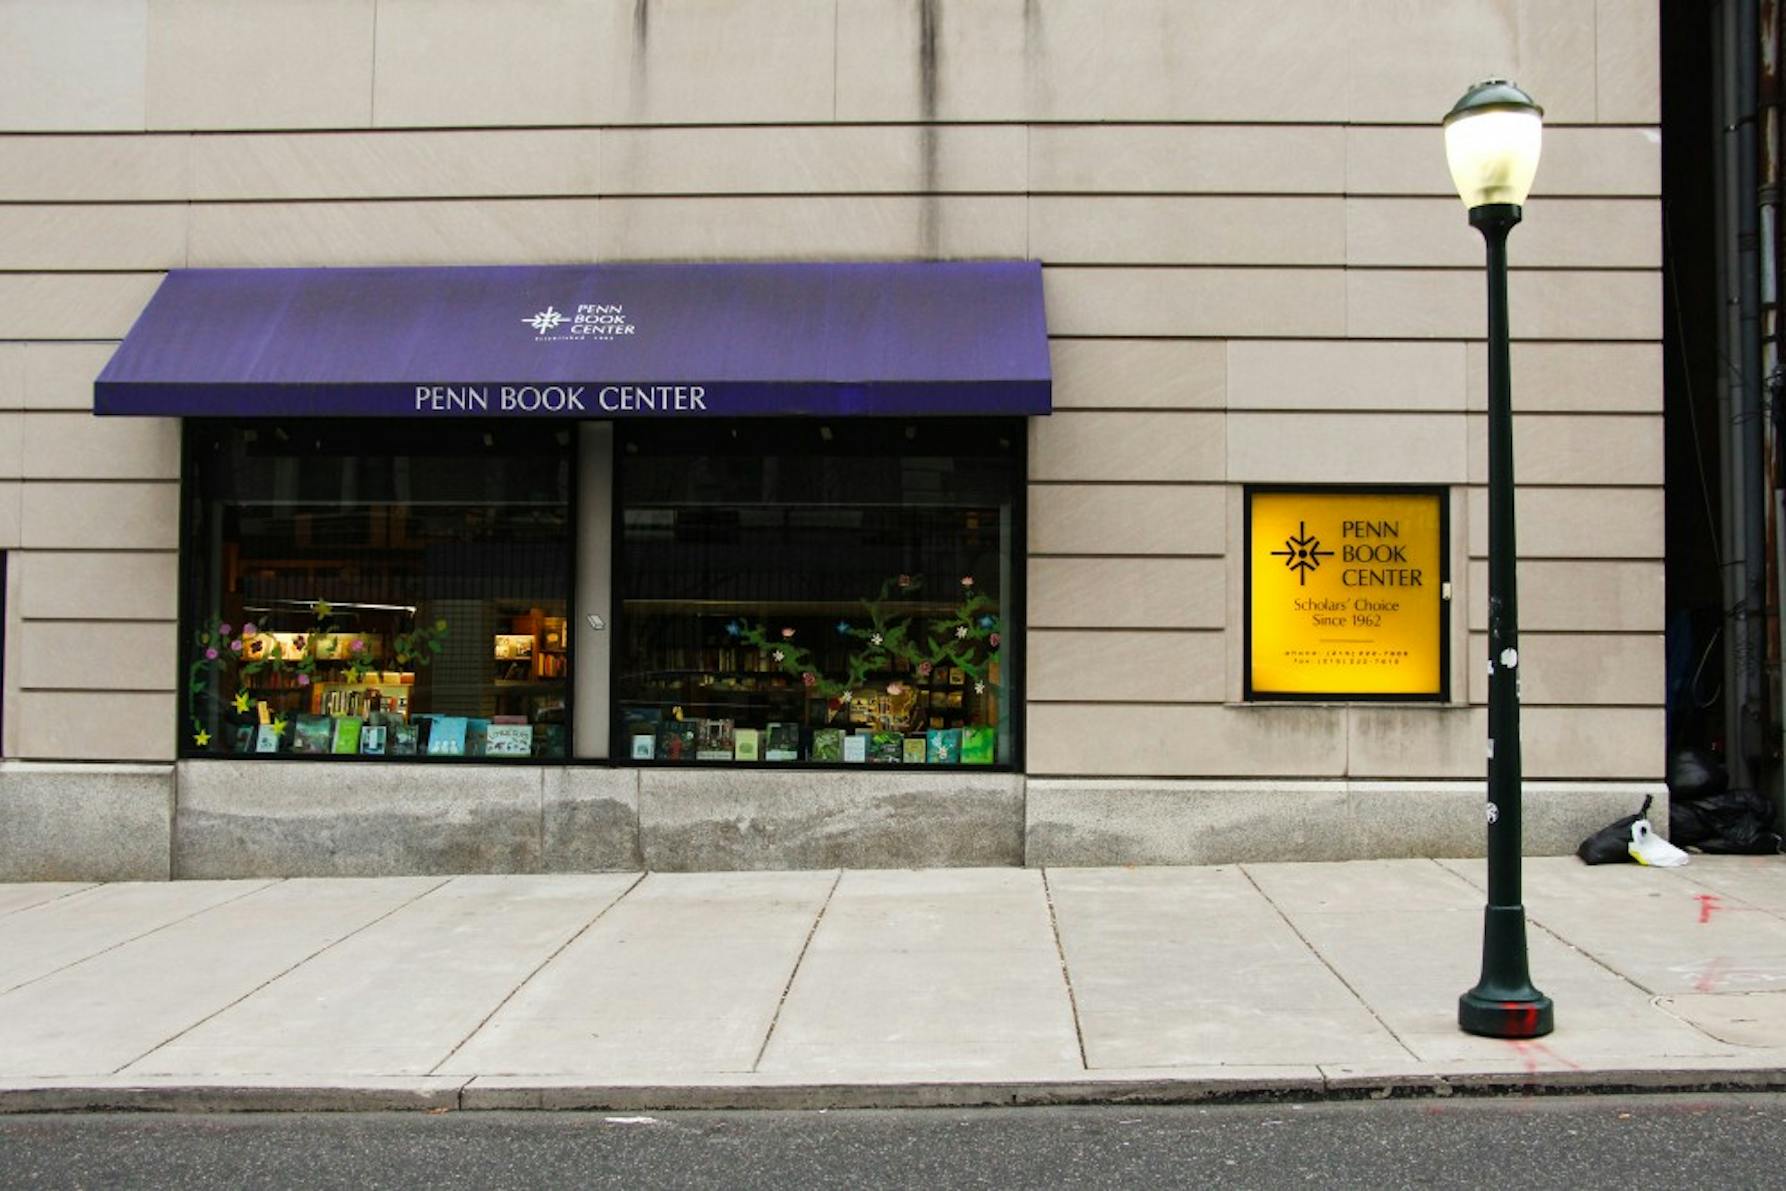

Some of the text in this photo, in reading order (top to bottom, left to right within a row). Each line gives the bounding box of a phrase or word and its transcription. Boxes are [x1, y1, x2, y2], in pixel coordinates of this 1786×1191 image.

[577, 304, 623, 313] PENN
[574, 314, 626, 324] BOOK
[570, 324, 635, 335] CENTER
[415, 386, 707, 411] PENN BOOK CENTER
[1342, 520, 1400, 538] PENN
[1342, 544, 1407, 563] BOOK
[1341, 568, 1423, 587] CENTER
[1353, 598, 1400, 612] Choice
[1311, 614, 1382, 627] Since 1962
